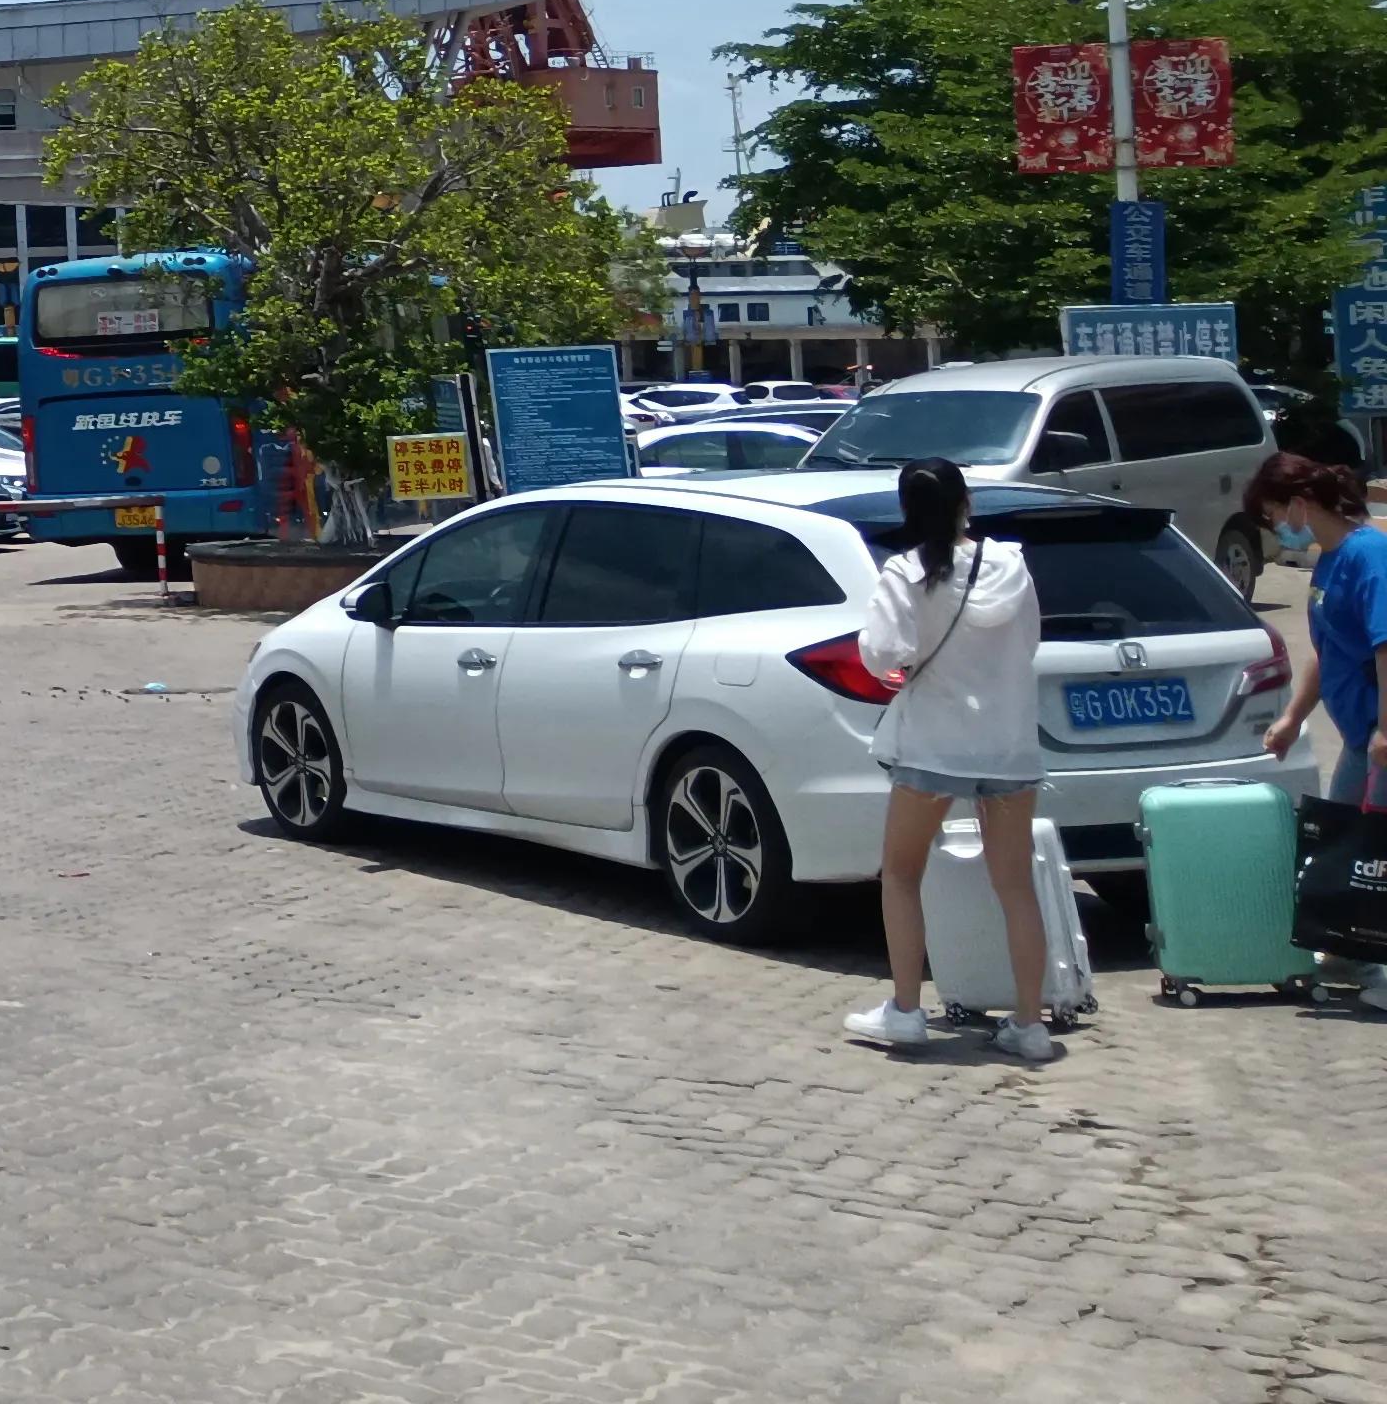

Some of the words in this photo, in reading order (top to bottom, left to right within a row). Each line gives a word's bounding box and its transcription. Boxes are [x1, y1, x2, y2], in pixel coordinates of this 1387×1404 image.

[1122, 204, 1155, 301] 公交车通道
[72, 410, 183, 431] 新国线快车
[394, 438, 461, 458] 停车场内
[397, 458, 463, 476] 可免费停
[398, 477, 464, 495] 车半小时
